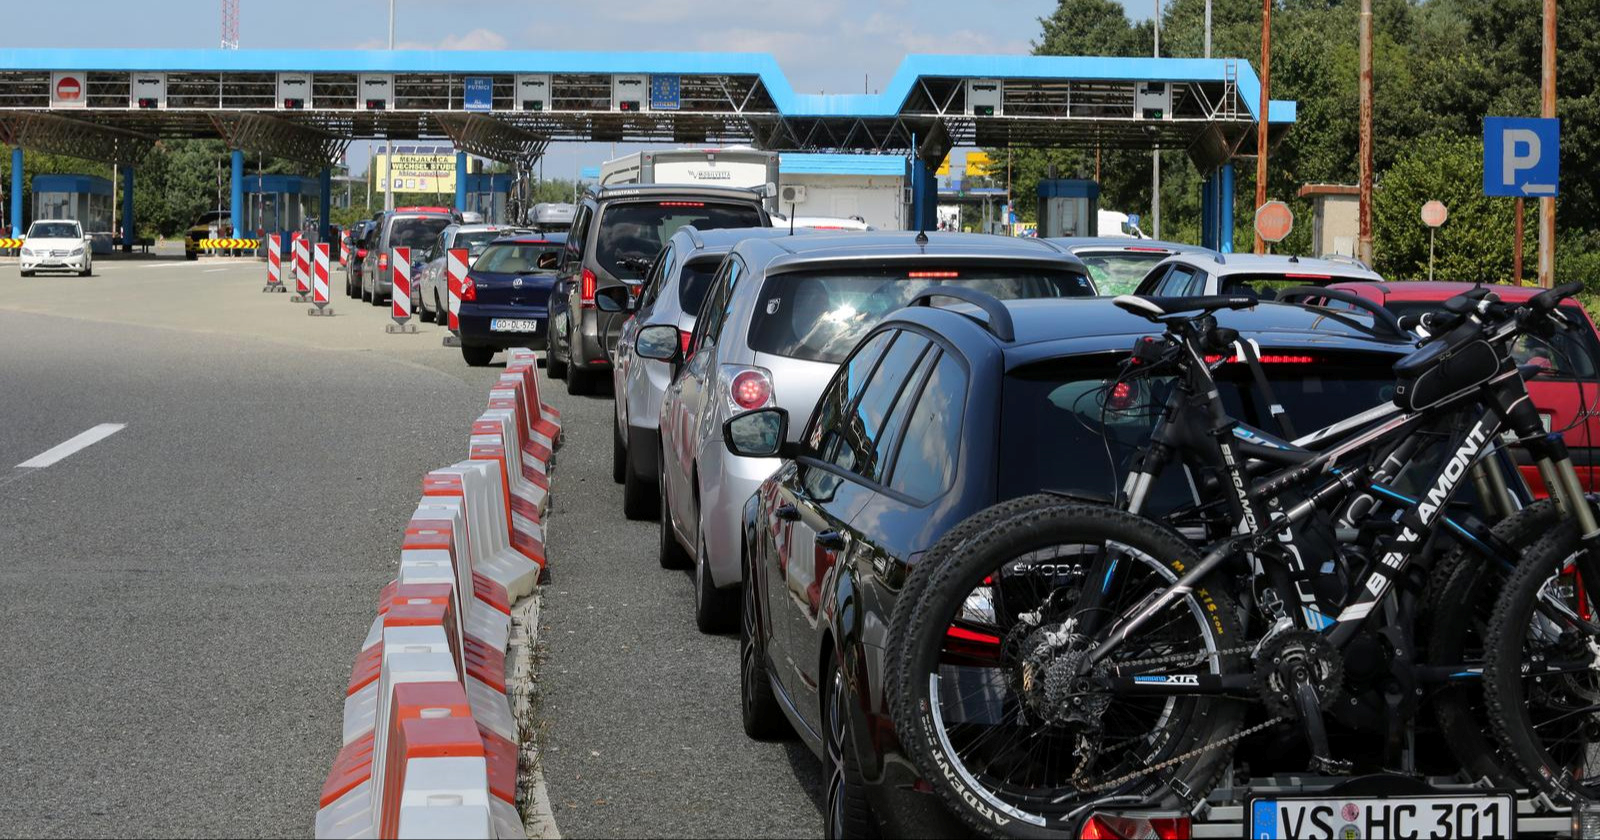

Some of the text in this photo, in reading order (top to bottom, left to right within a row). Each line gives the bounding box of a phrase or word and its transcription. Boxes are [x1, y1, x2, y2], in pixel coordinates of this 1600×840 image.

[1503, 129, 1541, 185] P
[1166, 674, 1198, 683] XTR
[931, 748, 1010, 826] ARDENT
[1280, 802, 1505, 839] VS HC 301
